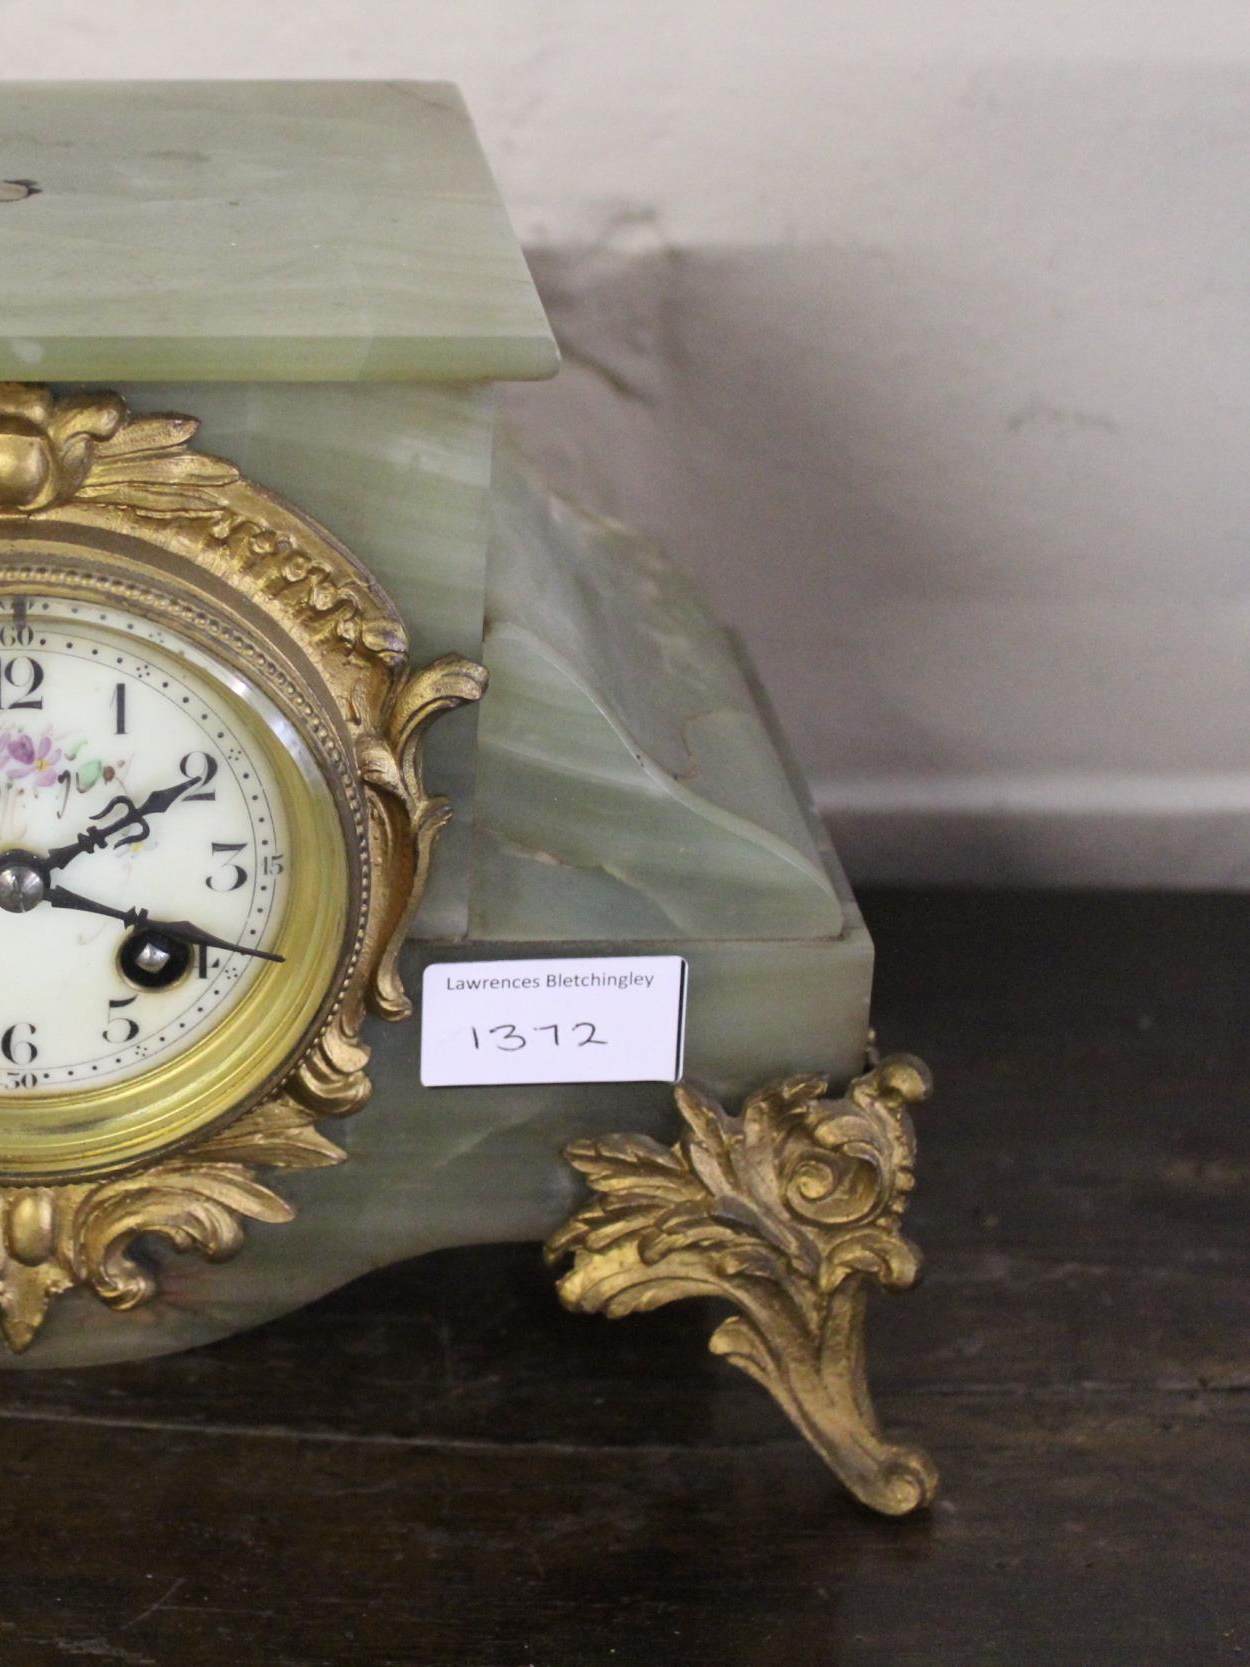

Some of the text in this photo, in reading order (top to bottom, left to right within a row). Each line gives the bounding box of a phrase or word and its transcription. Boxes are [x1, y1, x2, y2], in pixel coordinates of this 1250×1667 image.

[0, 627, 33, 648] 60
[111, 682, 128, 735] 1
[179, 751, 218, 802] 2
[205, 841, 248, 893] 3
[260, 855, 284, 877] 15
[446, 971, 654, 991] Lawrences Bletchingley
[102, 998, 139, 1042] 5
[471, 1021, 608, 1051] 1372
[1, 1022, 37, 1066] 6
[3, 1071, 37, 1090] 30
